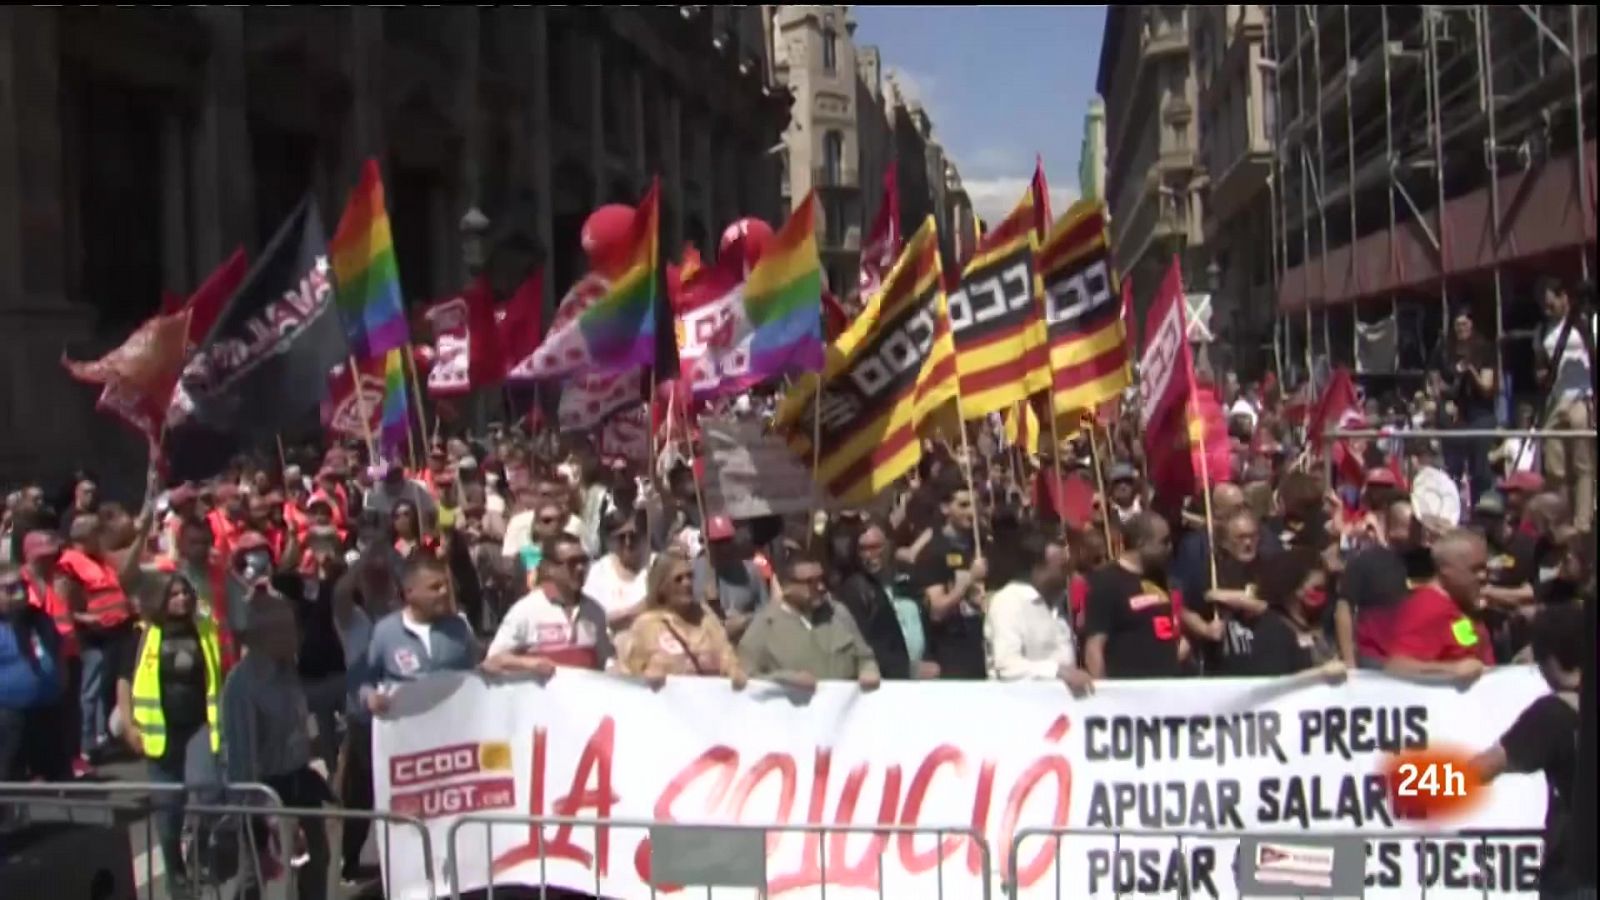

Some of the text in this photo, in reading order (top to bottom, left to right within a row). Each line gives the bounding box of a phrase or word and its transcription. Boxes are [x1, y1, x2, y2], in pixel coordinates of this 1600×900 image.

[395, 749, 473, 780] CCOO
[1084, 706, 1428, 768] CONTENIR PREUS
[493, 713, 1070, 893] LA SOLUCIÓ
[1087, 774, 1428, 830] APUJAR SALAR
[1087, 846, 1219, 898] POSAR
